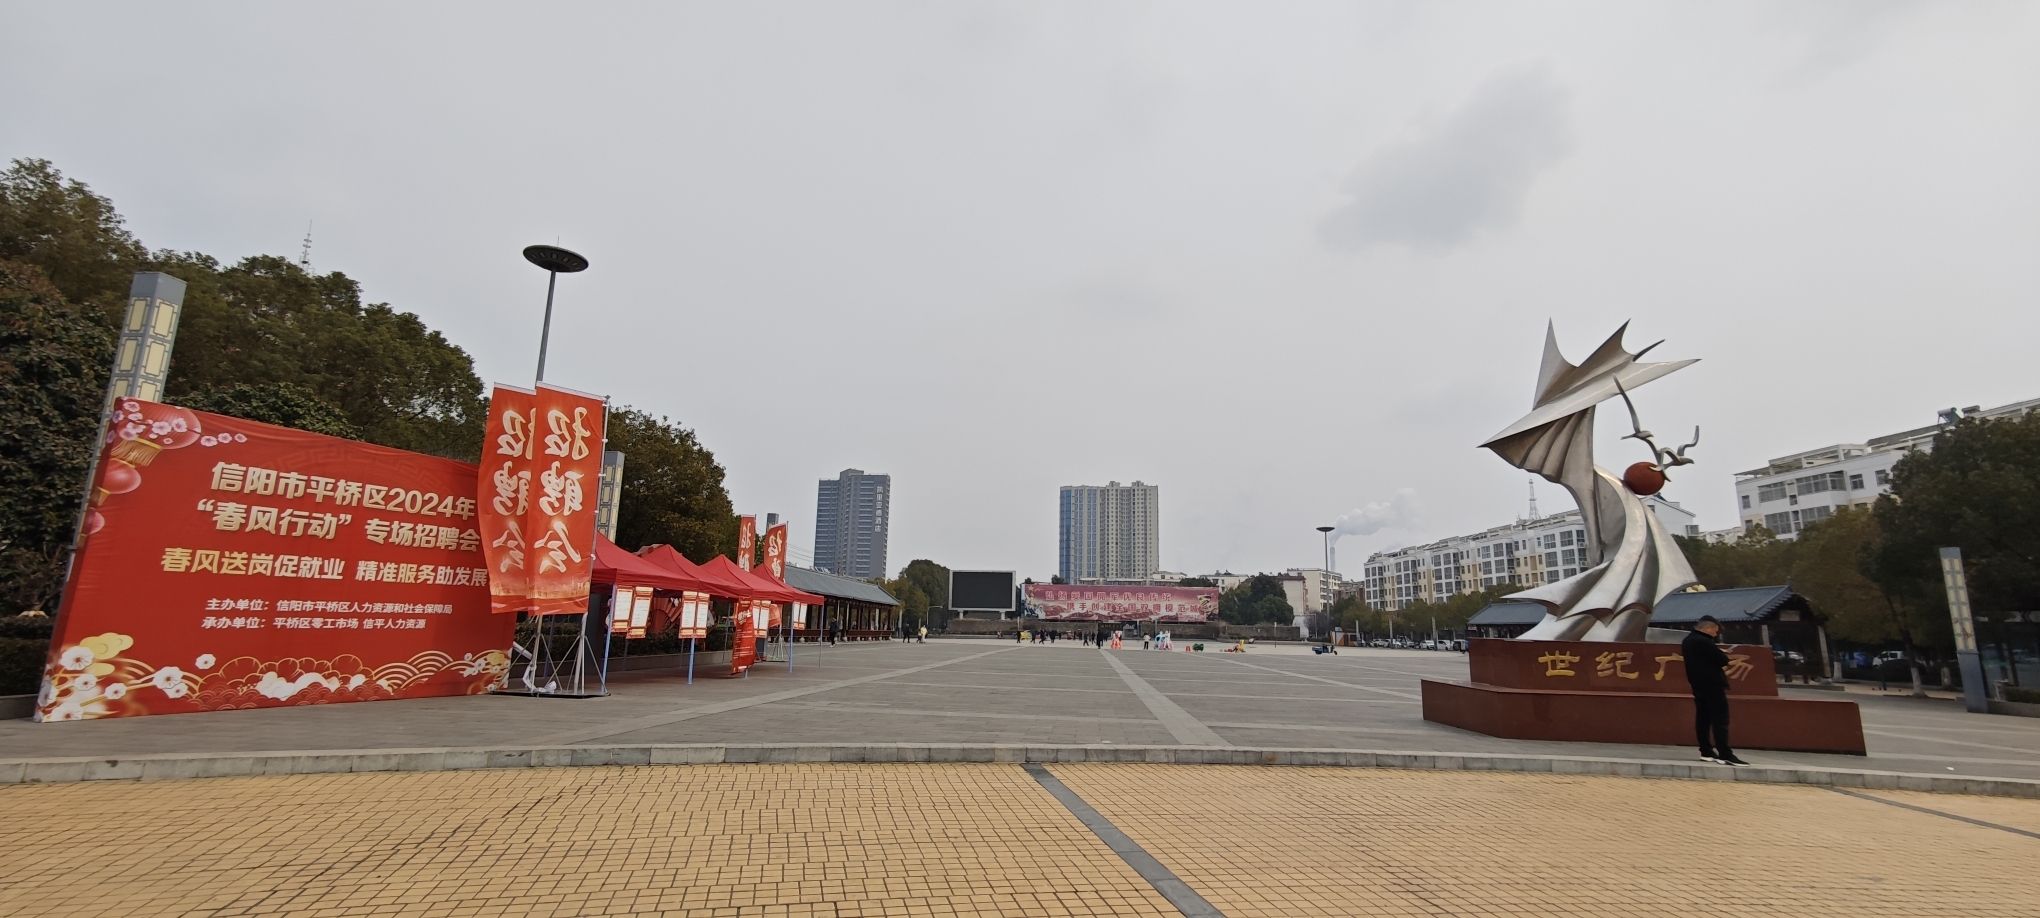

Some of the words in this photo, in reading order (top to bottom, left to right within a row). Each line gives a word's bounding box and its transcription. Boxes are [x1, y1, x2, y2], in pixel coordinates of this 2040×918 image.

[211, 461, 476, 521] 信阳市平桥区2024年
[197, 498, 352, 540] “春风行动”
[364, 518, 481, 552] 专场招聘会
[160, 547, 345, 580] 春风送岗促就业
[355, 559, 487, 587] 精准服务助发展
[362, 617, 427, 630] 信平人力资源
